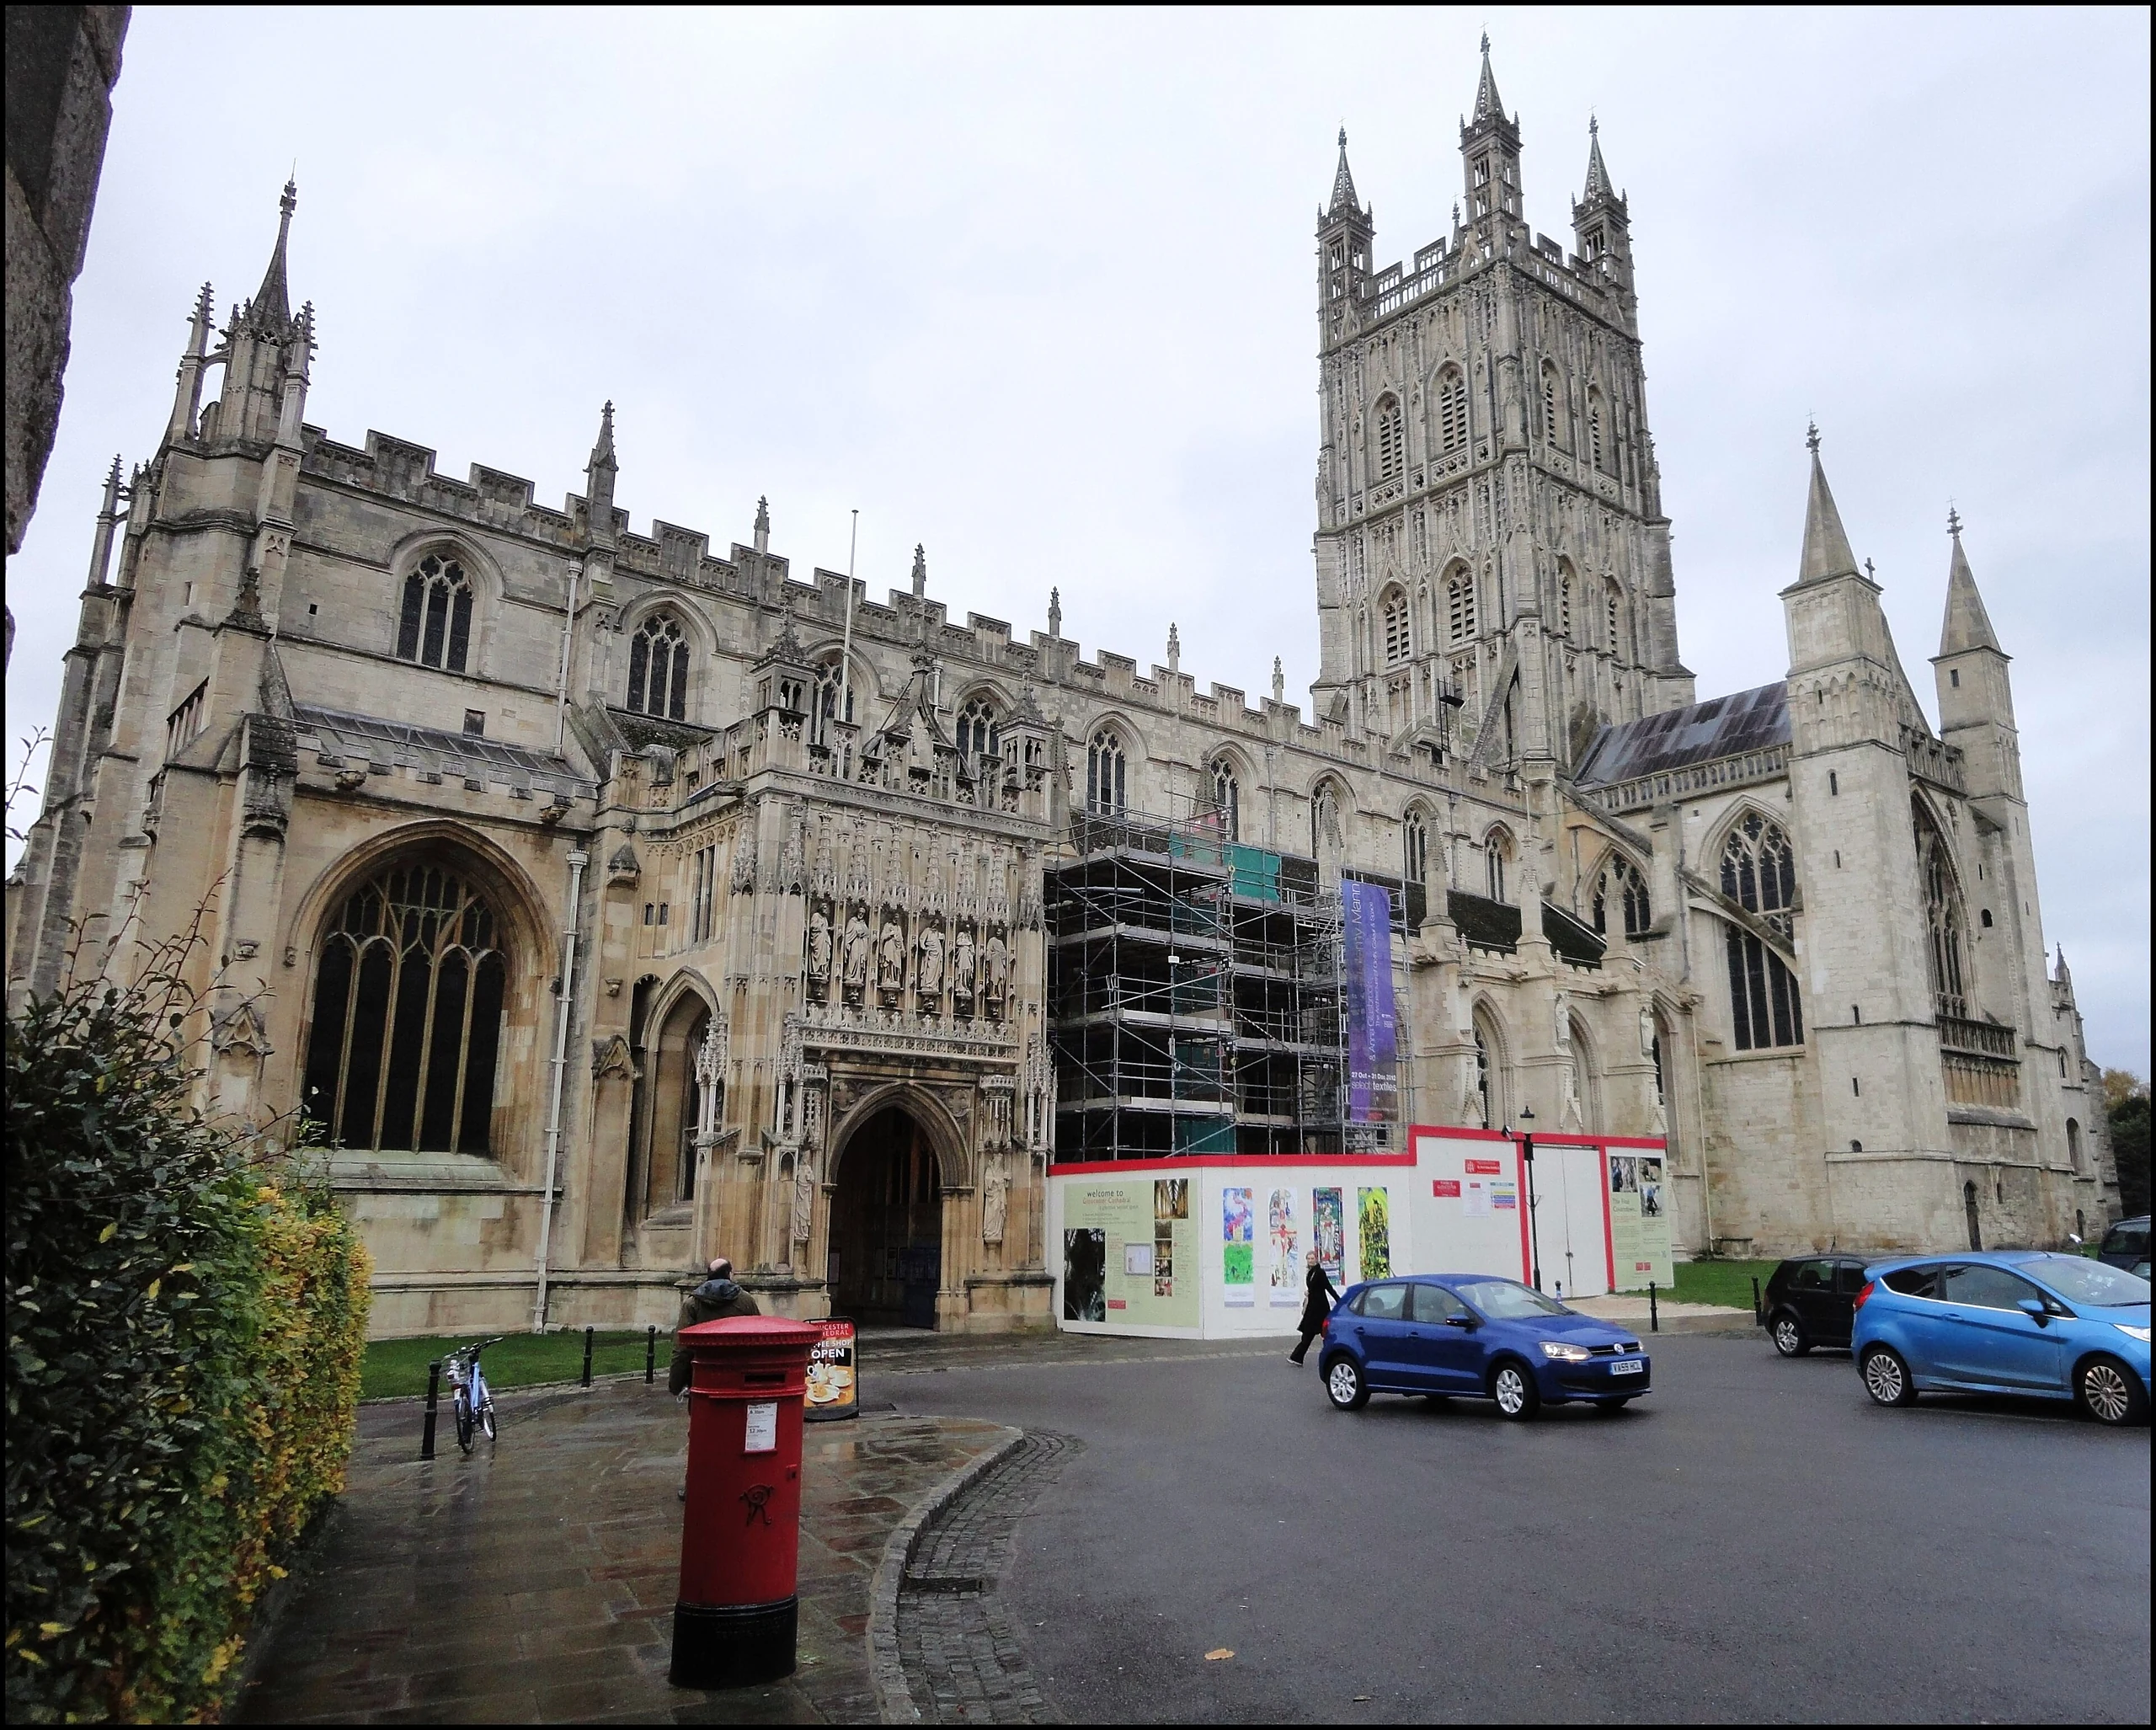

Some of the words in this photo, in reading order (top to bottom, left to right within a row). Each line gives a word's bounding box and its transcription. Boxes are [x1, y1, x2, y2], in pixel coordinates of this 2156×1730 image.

[1351, 884, 1362, 924] Mann
[1352, 1080, 1370, 1090] select
[1373, 1081, 1396, 1092] textiles
[1086, 1188, 1114, 1197] welcome
[811, 1348, 845, 1359] OPEN
